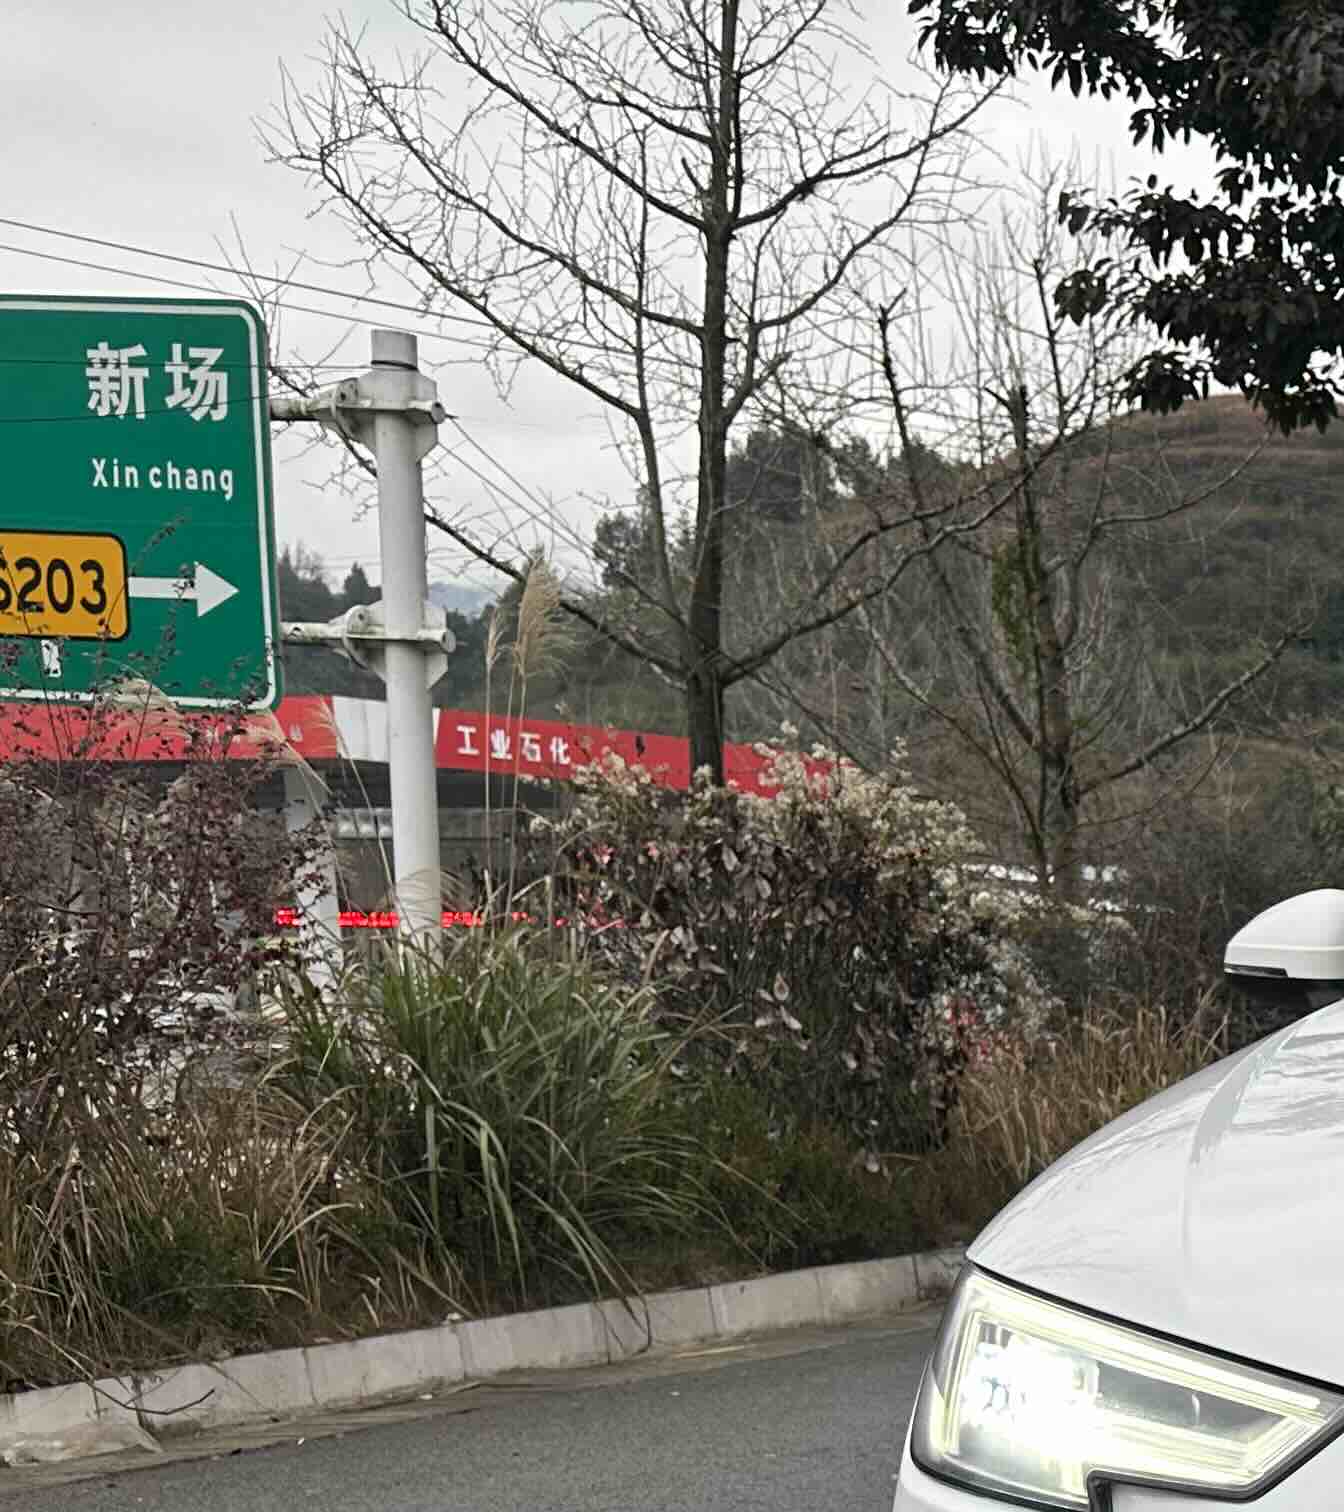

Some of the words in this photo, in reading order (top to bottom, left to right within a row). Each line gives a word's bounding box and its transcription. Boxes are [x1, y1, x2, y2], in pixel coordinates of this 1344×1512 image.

[85, 341, 229, 422] 新场
[92, 457, 140, 489] Xin
[149, 461, 234, 501] chang
[455, 723, 572, 766] 工业石化
